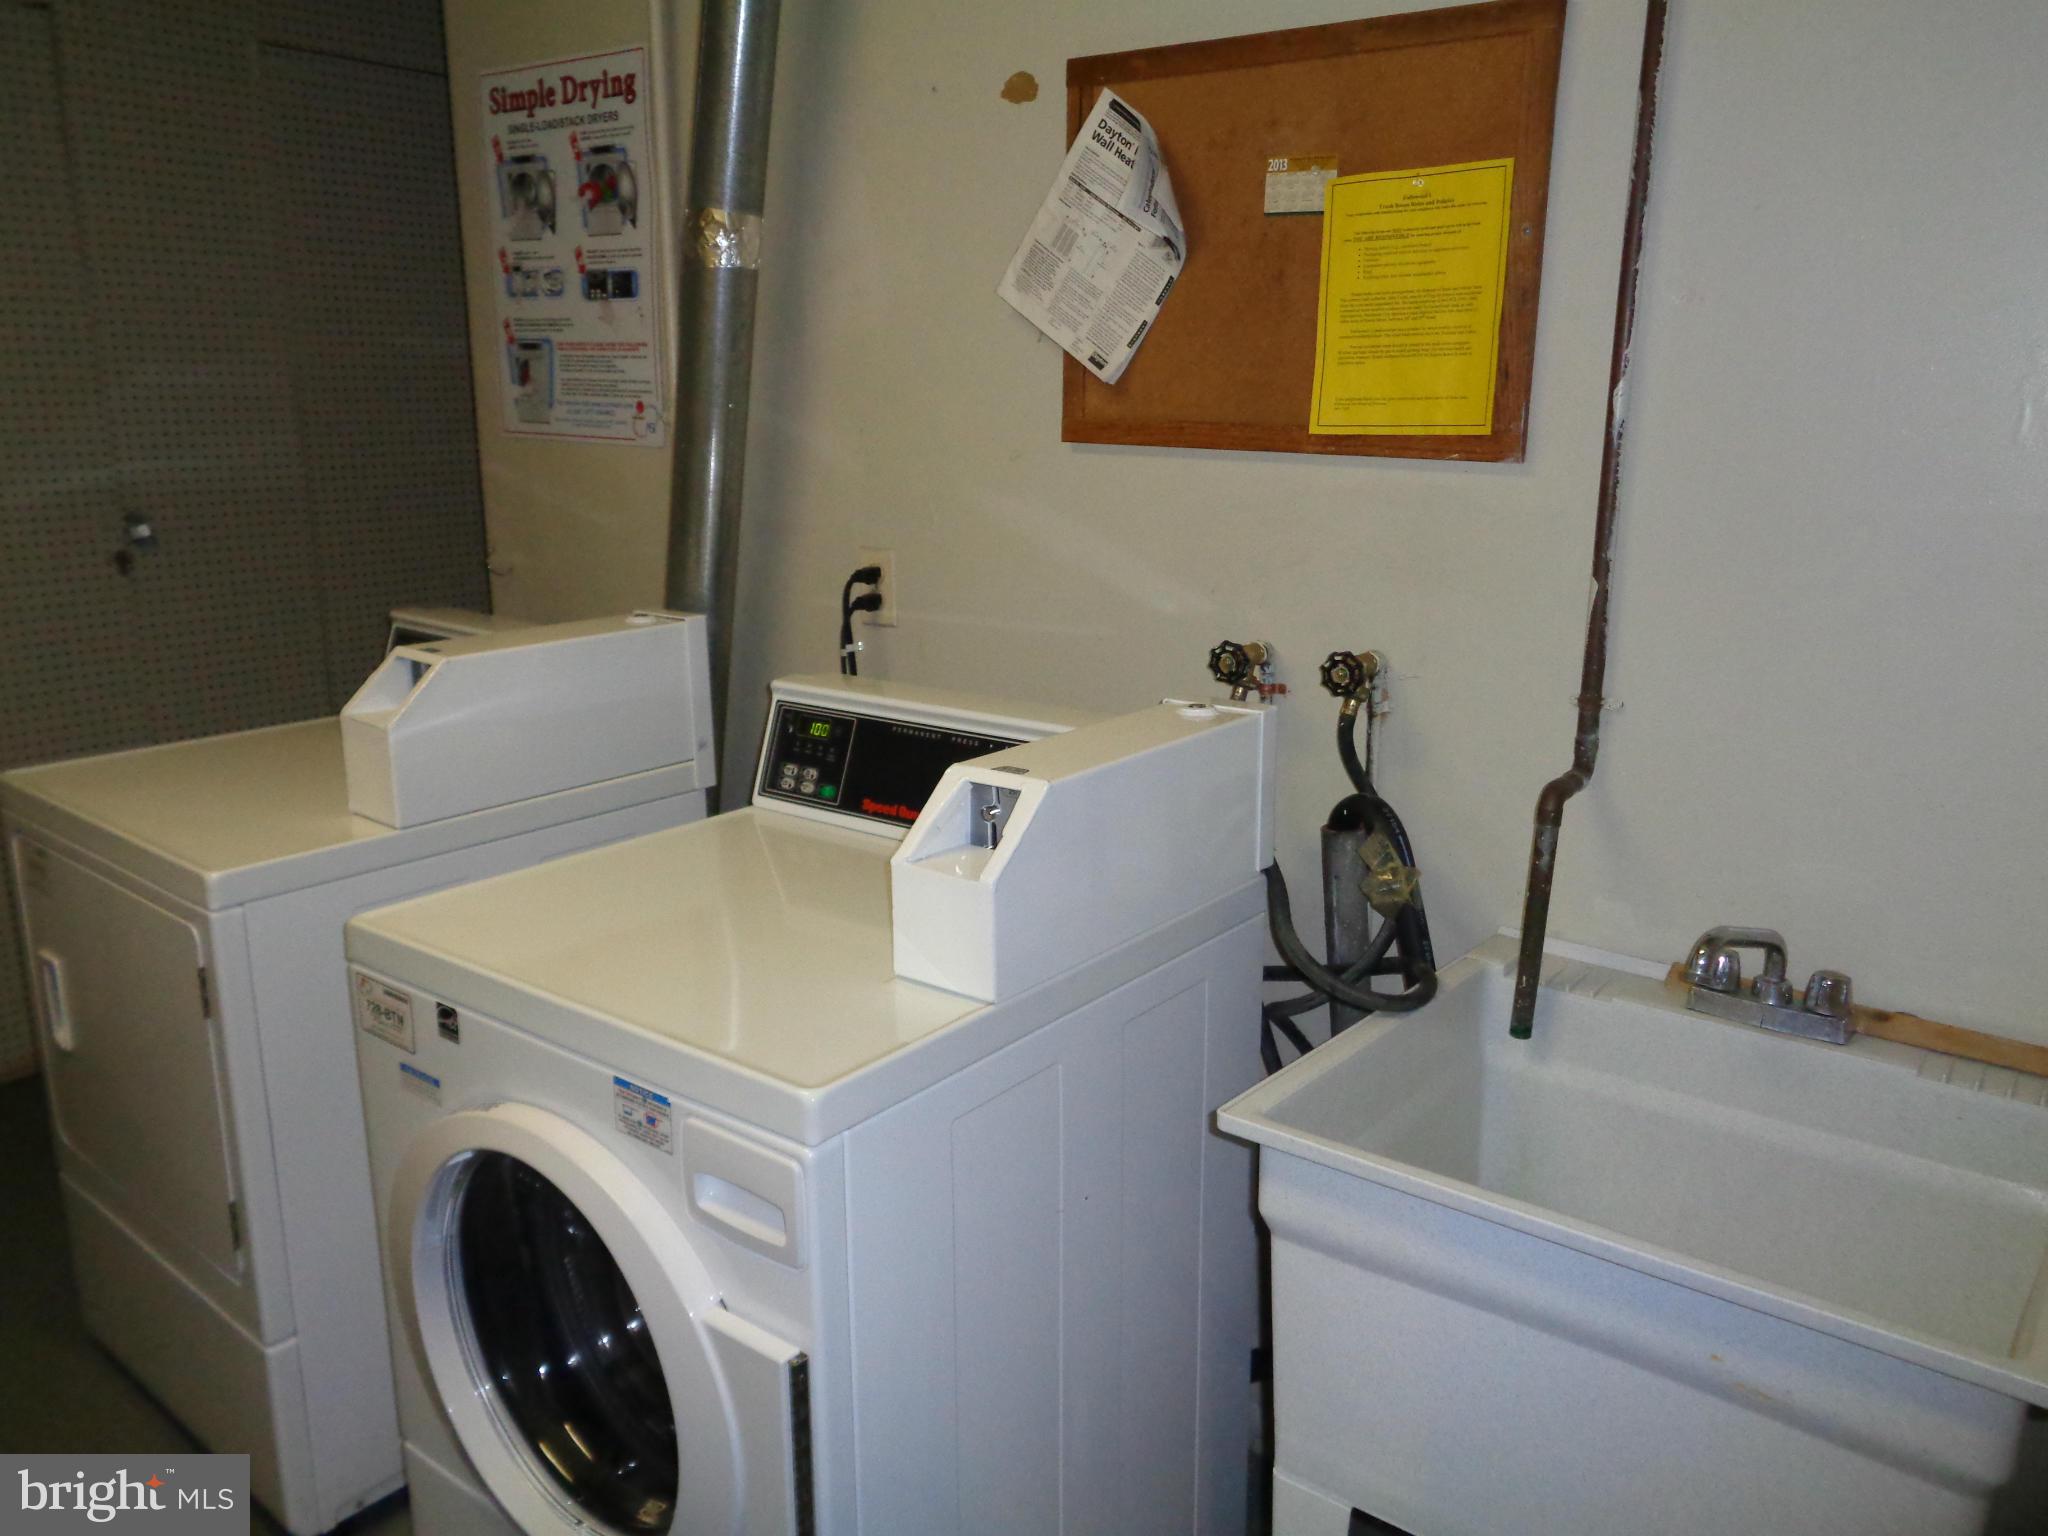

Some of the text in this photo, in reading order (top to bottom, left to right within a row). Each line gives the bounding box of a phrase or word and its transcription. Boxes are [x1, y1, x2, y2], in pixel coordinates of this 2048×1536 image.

[489, 69, 637, 118] Simple Drying
[587, 110, 620, 125] DRYERS
[1092, 130, 1115, 152] Wall
[1268, 158, 1288, 172] 2013
[810, 722, 829, 737] 100
[891, 726, 980, 747] PERMANENT PRESS
